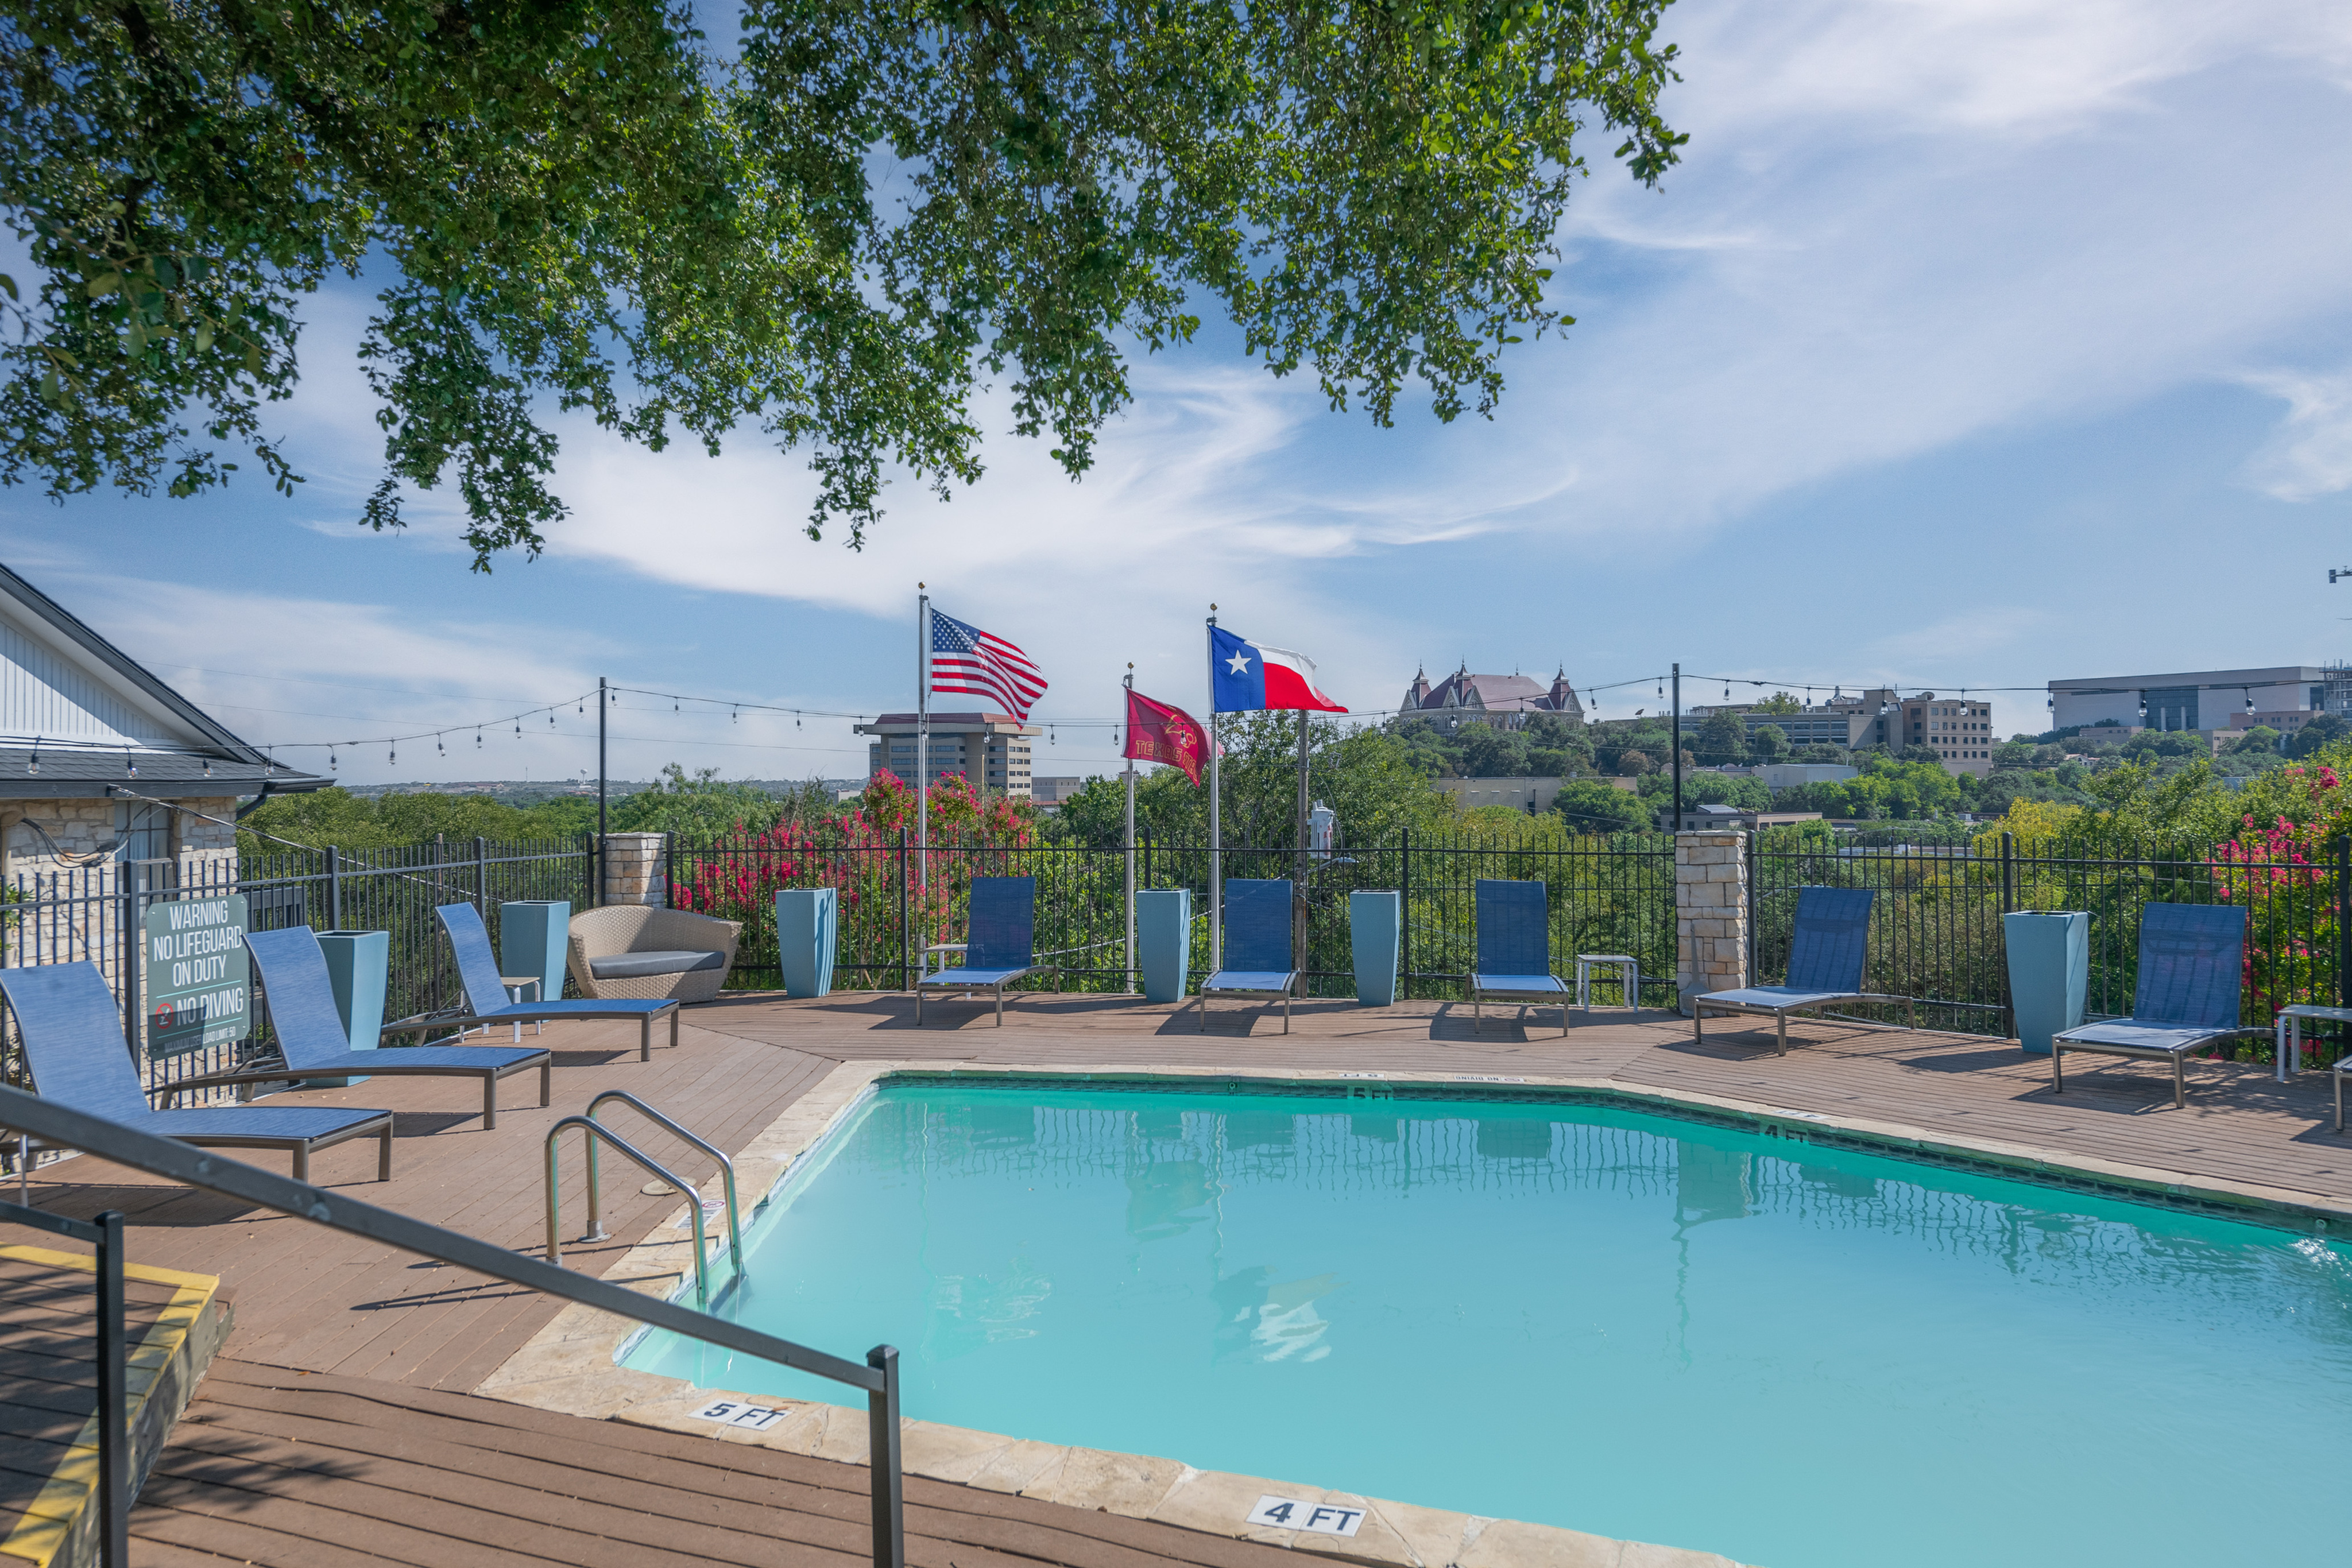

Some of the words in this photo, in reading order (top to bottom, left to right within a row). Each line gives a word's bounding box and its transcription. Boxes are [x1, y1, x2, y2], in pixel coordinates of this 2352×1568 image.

[1136, 740, 1182, 761] TEXAS
[169, 900, 228, 930] WARNING
[154, 935, 172, 962] NO
[176, 926, 242, 958] LIFEGUARD
[173, 960, 191, 987] ON
[195, 954, 227, 984] DUTY
[177, 997, 196, 1026] NO
[200, 987, 243, 1020] DIVING
[203, 1031, 215, 1044] LOAD
[703, 1403, 738, 1417] 5
[733, 1408, 786, 1426] FT
[1264, 1502, 1295, 1523] 4
[1306, 1507, 1360, 1531] FT
